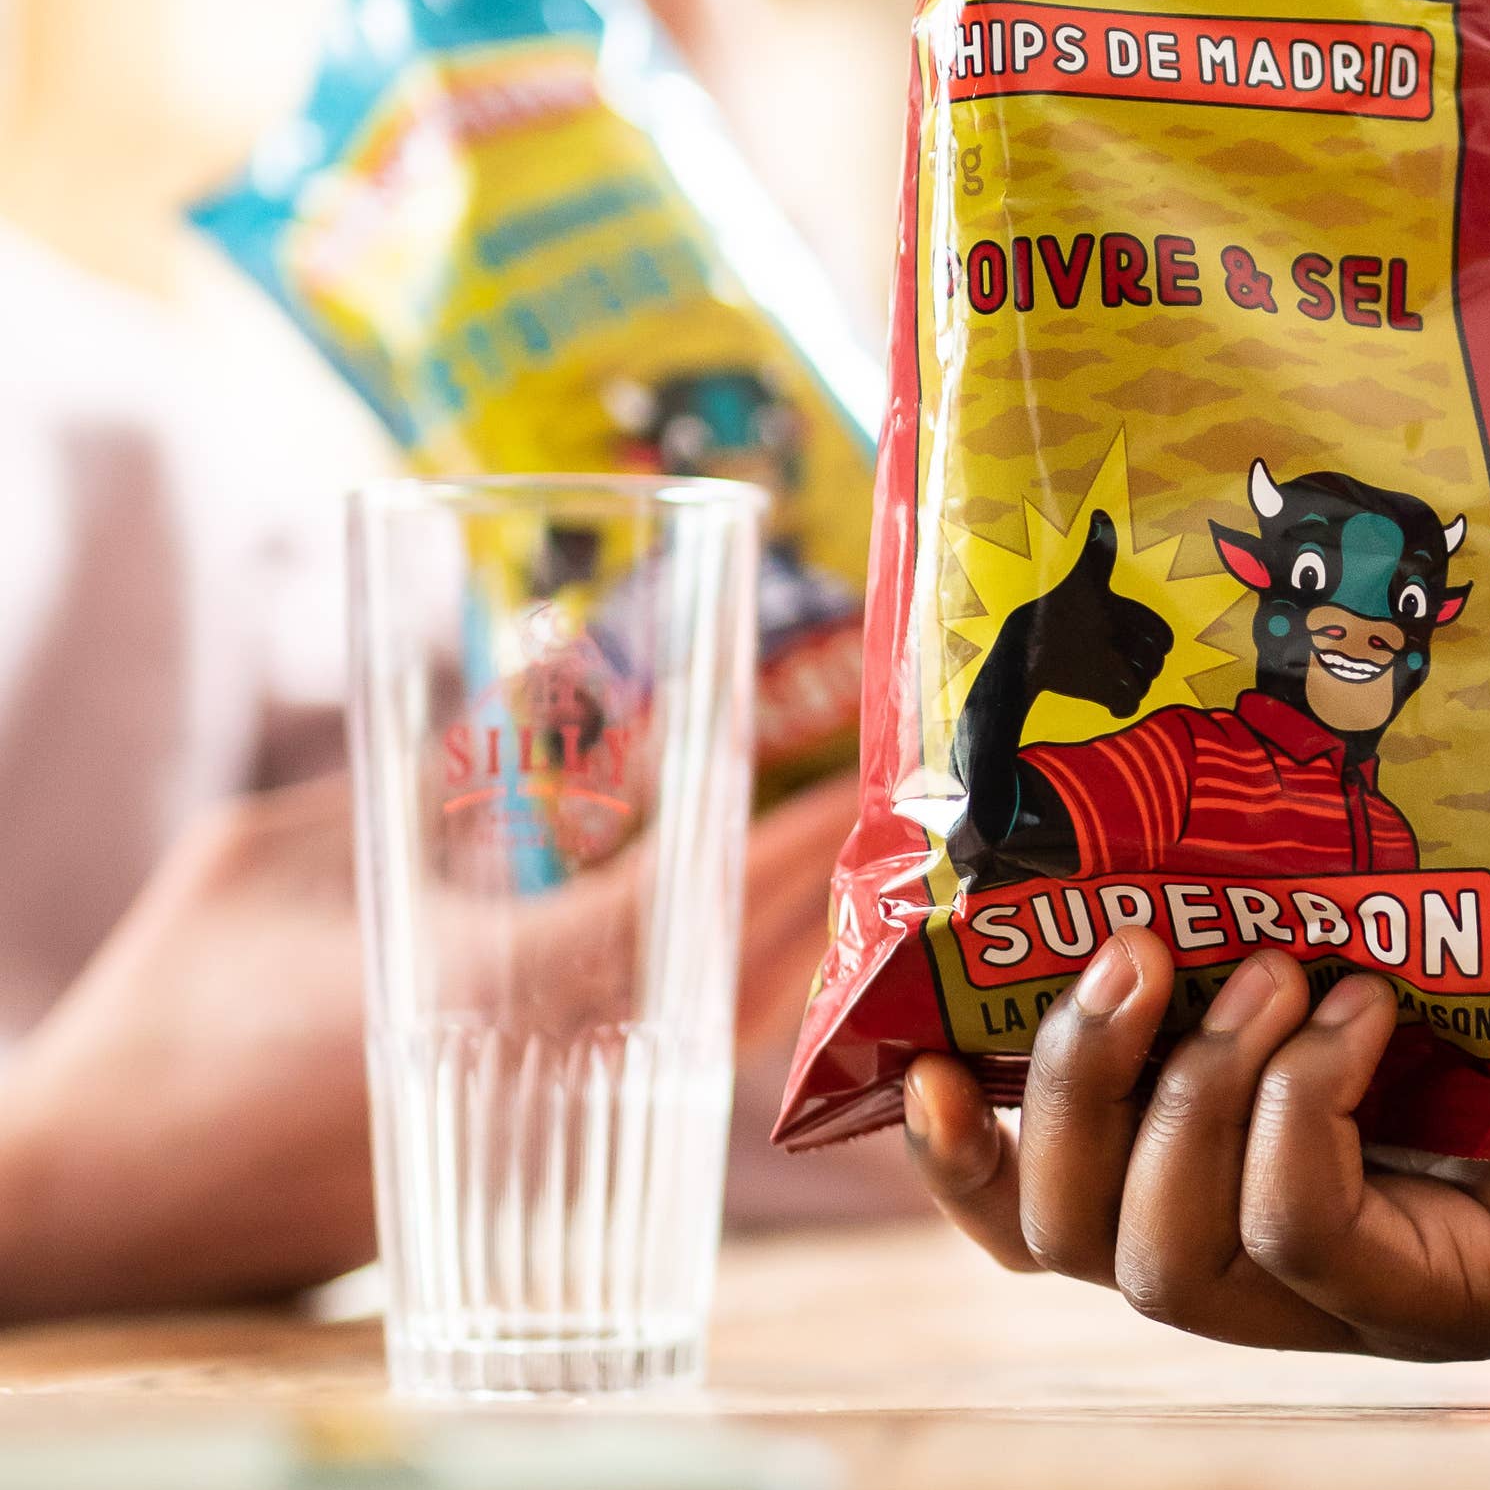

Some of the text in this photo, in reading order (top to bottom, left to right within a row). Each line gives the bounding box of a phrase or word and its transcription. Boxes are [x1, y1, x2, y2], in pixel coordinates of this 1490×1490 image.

[938, 20, 1420, 99] HIPS DE MADRID
[1221, 245, 1278, 313] &
[1291, 252, 1423, 331] SEL
[443, 721, 631, 786] SILLY
[971, 882, 1480, 977] SUPERBON
[980, 996, 1027, 1035] LA
